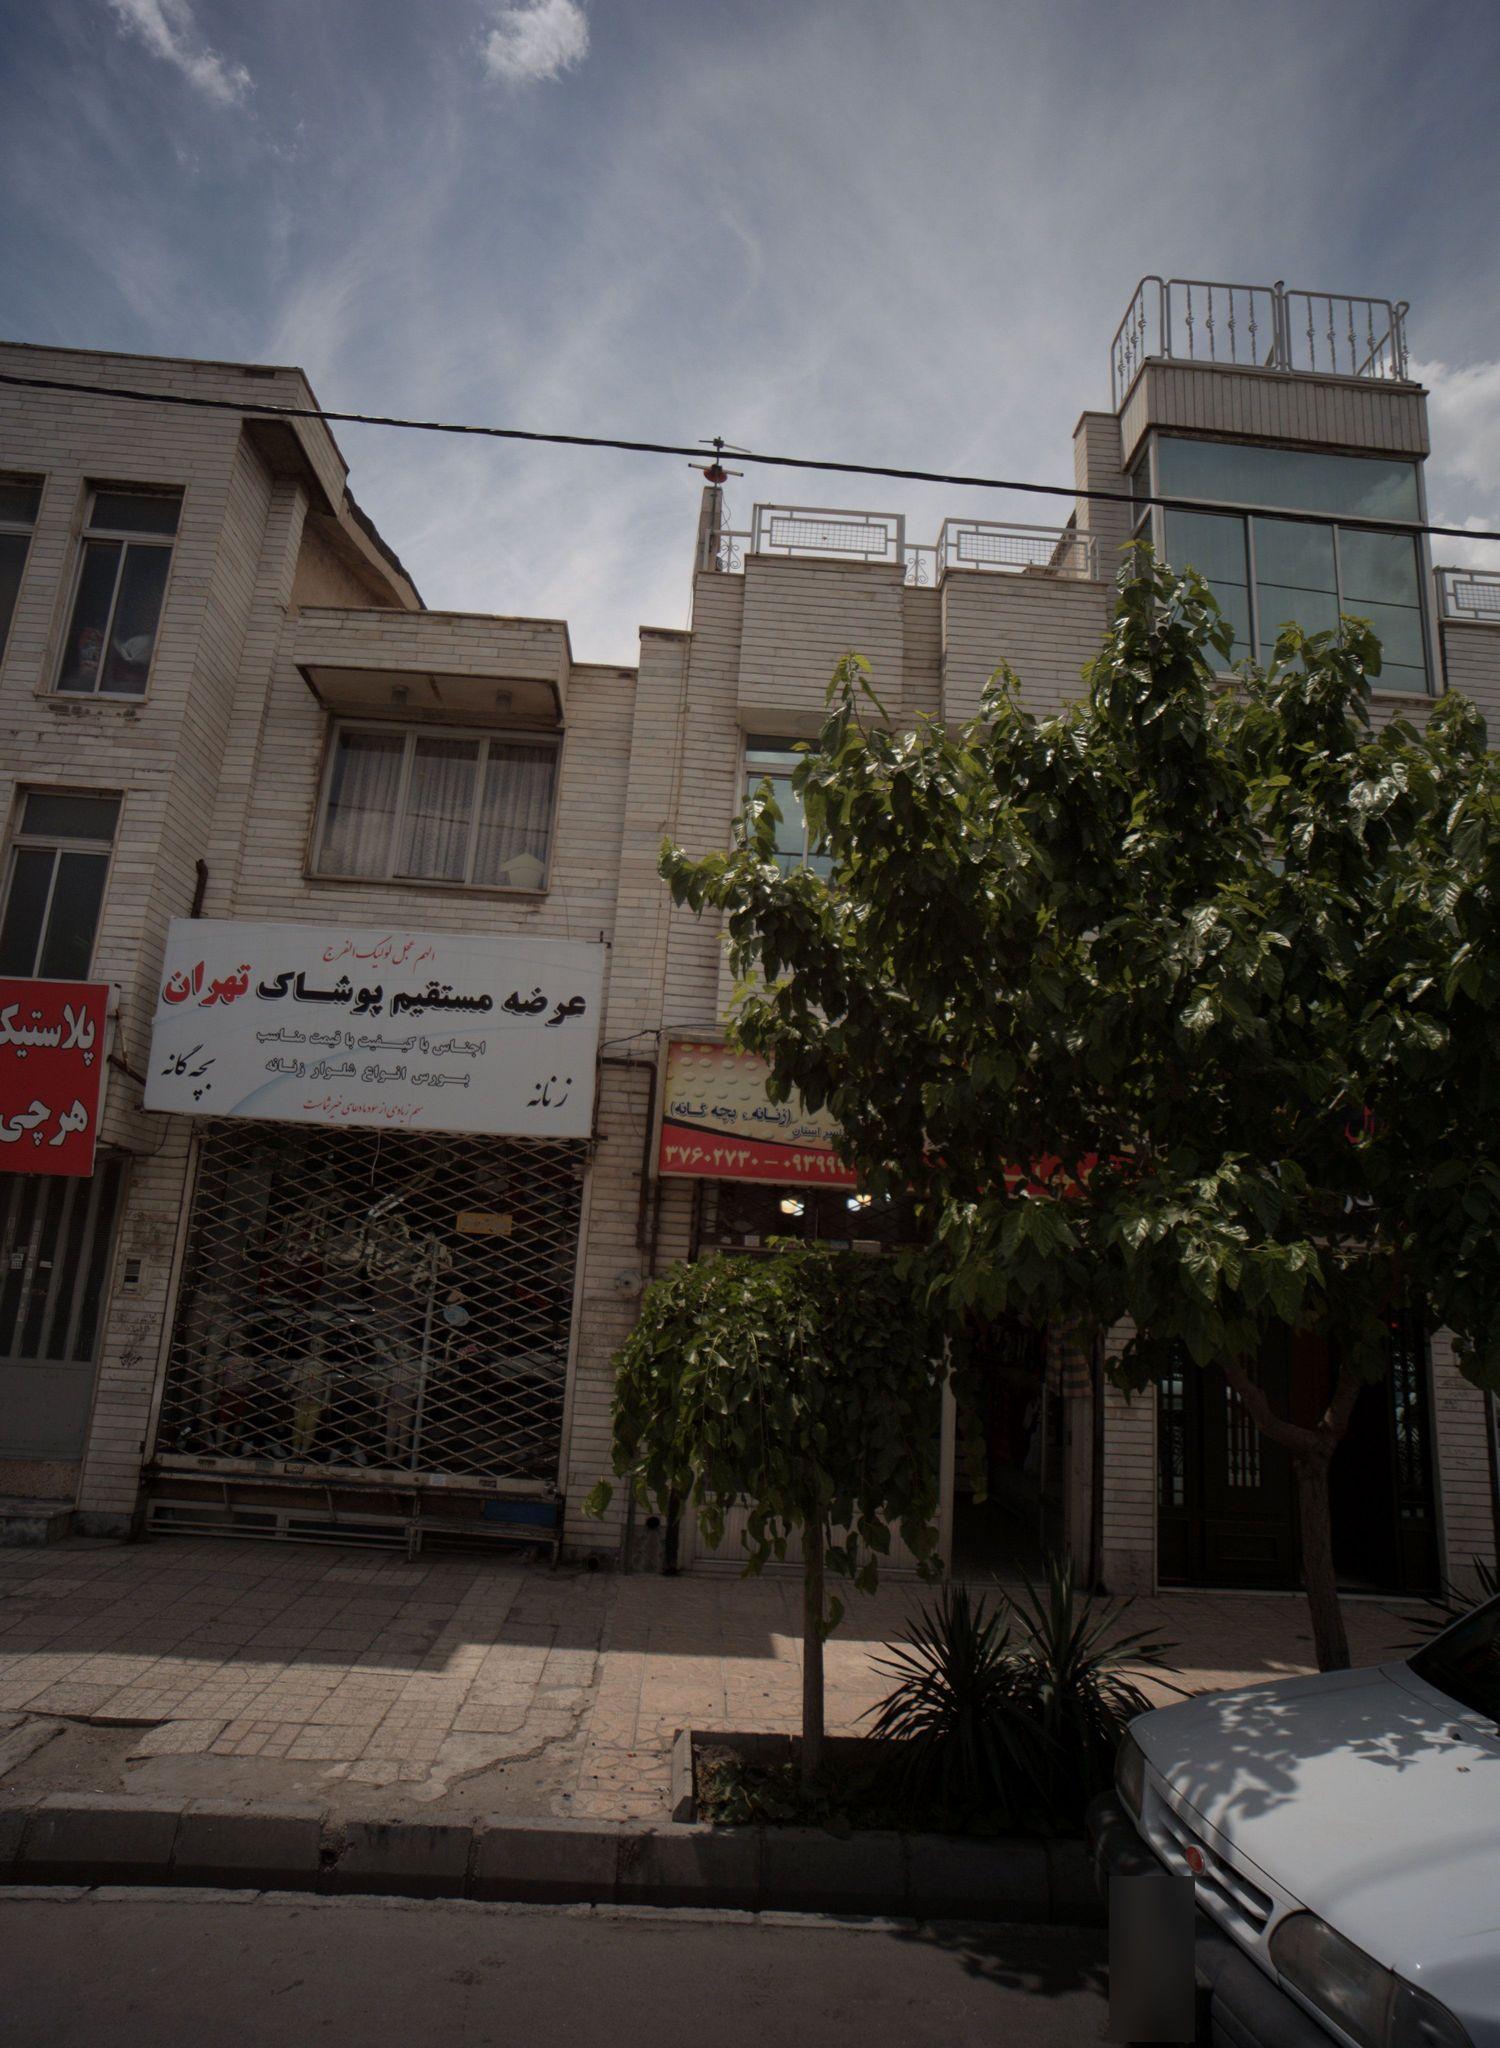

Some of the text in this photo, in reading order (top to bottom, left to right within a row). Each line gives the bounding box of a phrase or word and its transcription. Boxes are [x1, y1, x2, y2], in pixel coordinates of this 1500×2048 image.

[163, 961, 587, 1027] عرضه مستقیم پوشاک تهران
[256, 1027, 487, 1057] اجناس با کیفیت با قیمت مناسب
[265, 1057, 471, 1088] بورس انواع شلوار زنانه
[526, 1075, 573, 1109] زنانه
